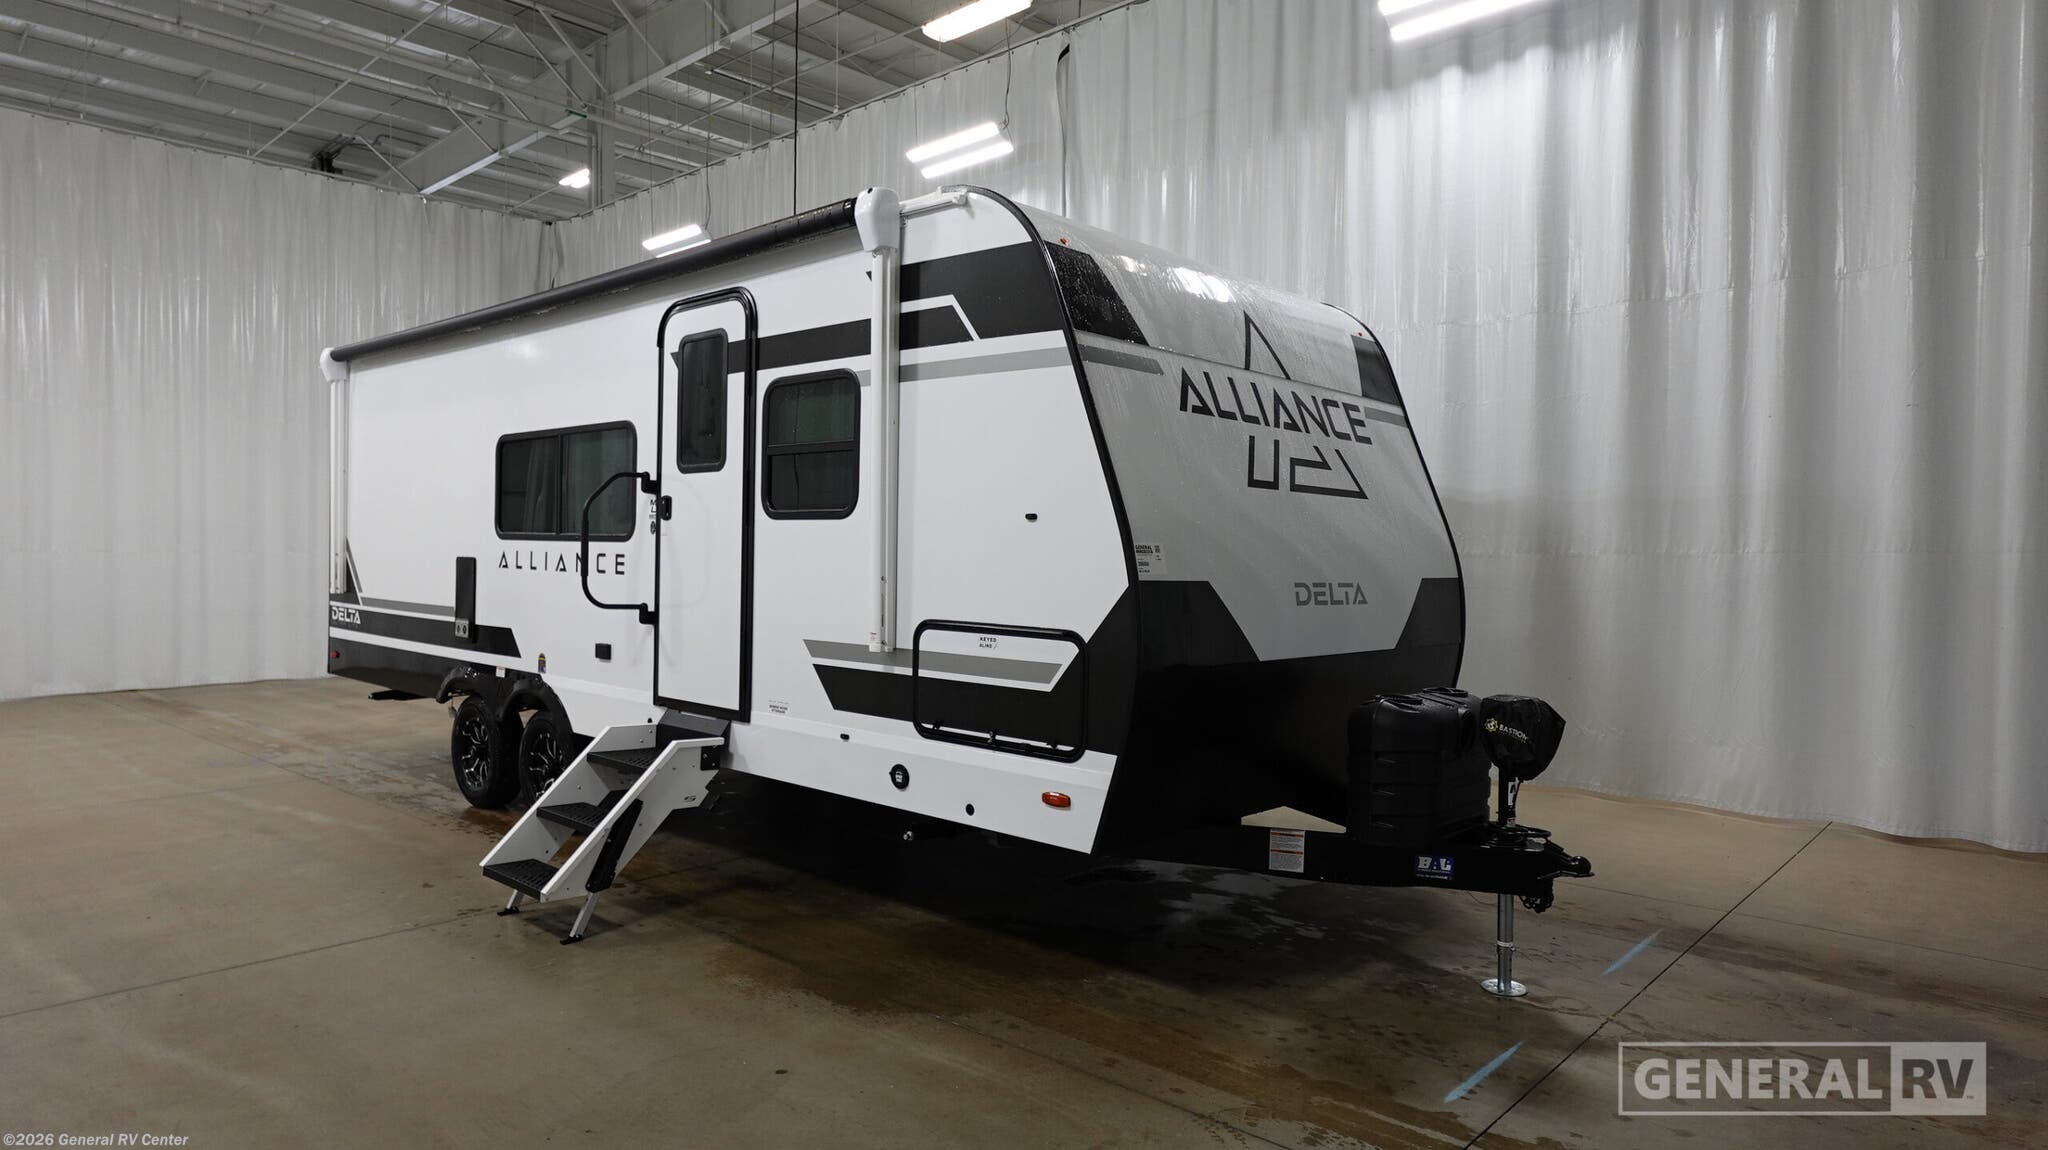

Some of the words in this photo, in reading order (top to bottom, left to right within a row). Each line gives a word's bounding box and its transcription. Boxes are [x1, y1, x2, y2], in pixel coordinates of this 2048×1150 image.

[1180, 367, 1373, 445] ALLIANCE
[1294, 582, 1369, 606] DELTA
[331, 606, 361, 625] DELTA
